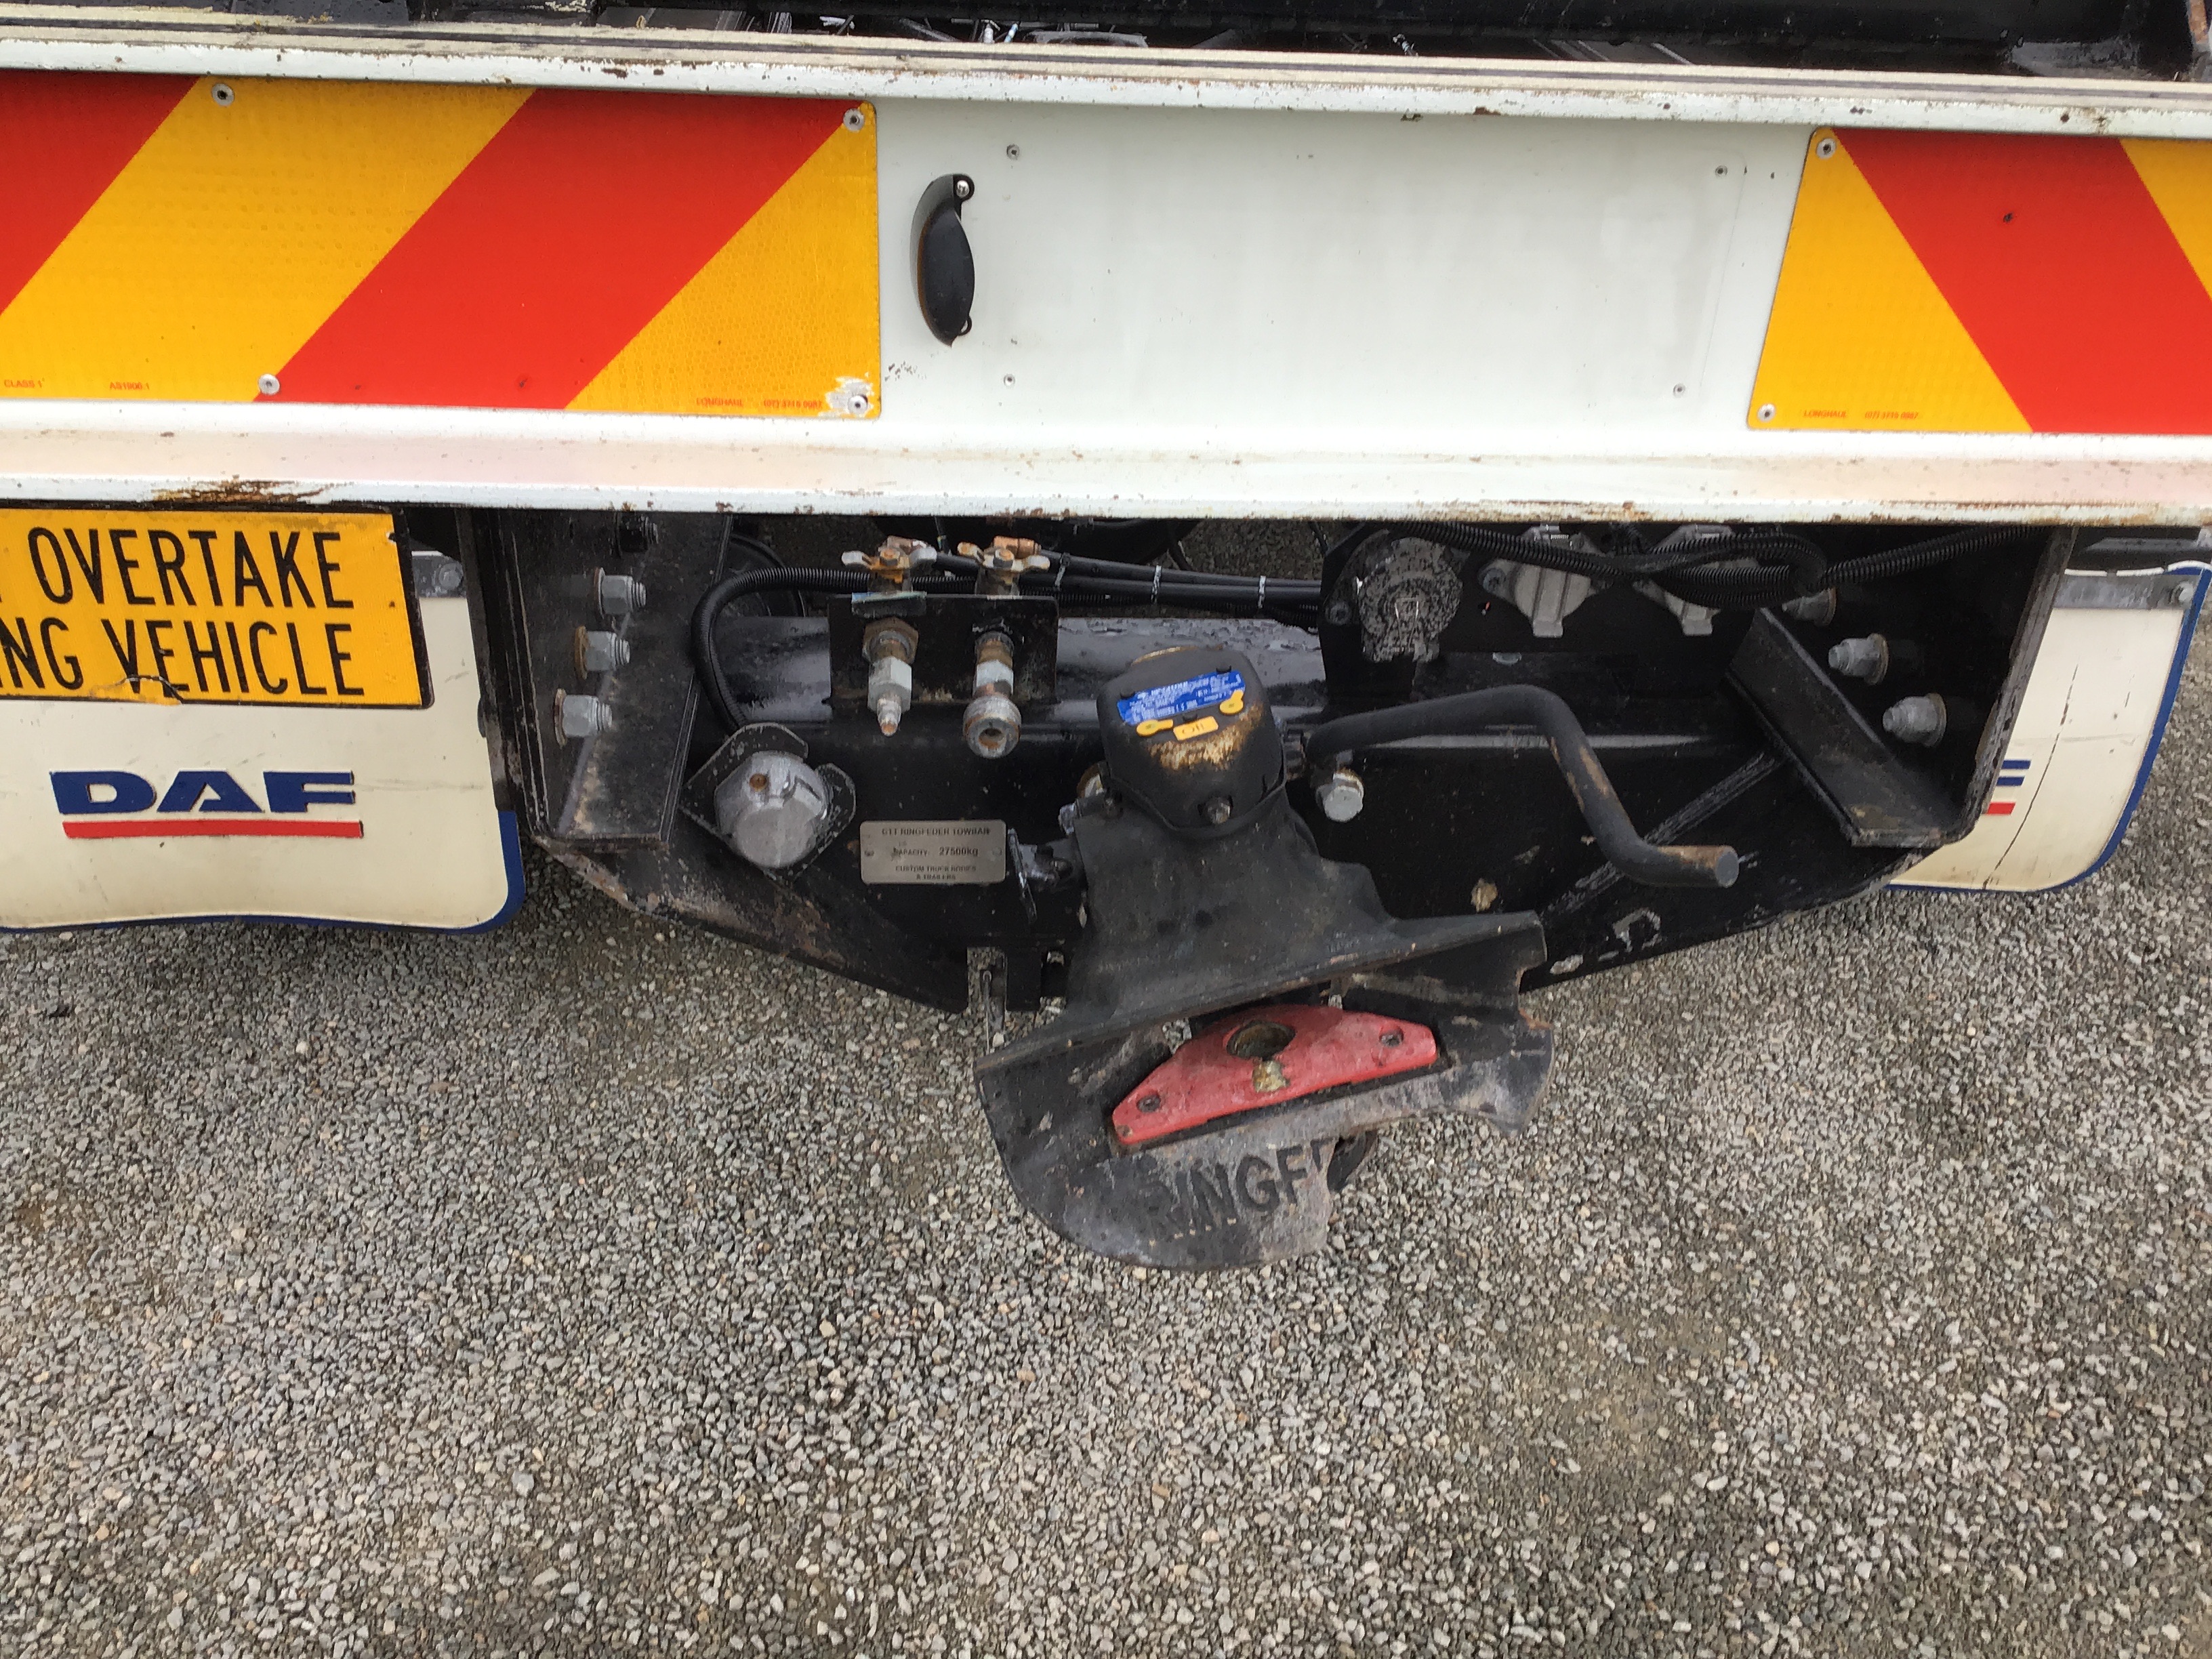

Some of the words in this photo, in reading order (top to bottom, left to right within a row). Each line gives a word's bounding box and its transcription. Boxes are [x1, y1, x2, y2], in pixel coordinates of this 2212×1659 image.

[4, 380, 35, 388] CLASS
[27, 527, 355, 609] OVERTAKE
[0, 617, 85, 691] NG
[100, 619, 365, 697] VEHICLE
[49, 770, 356, 815] DAF
[952, 827, 991, 836] TOWBAR
[939, 846, 979, 857] 27500kg
